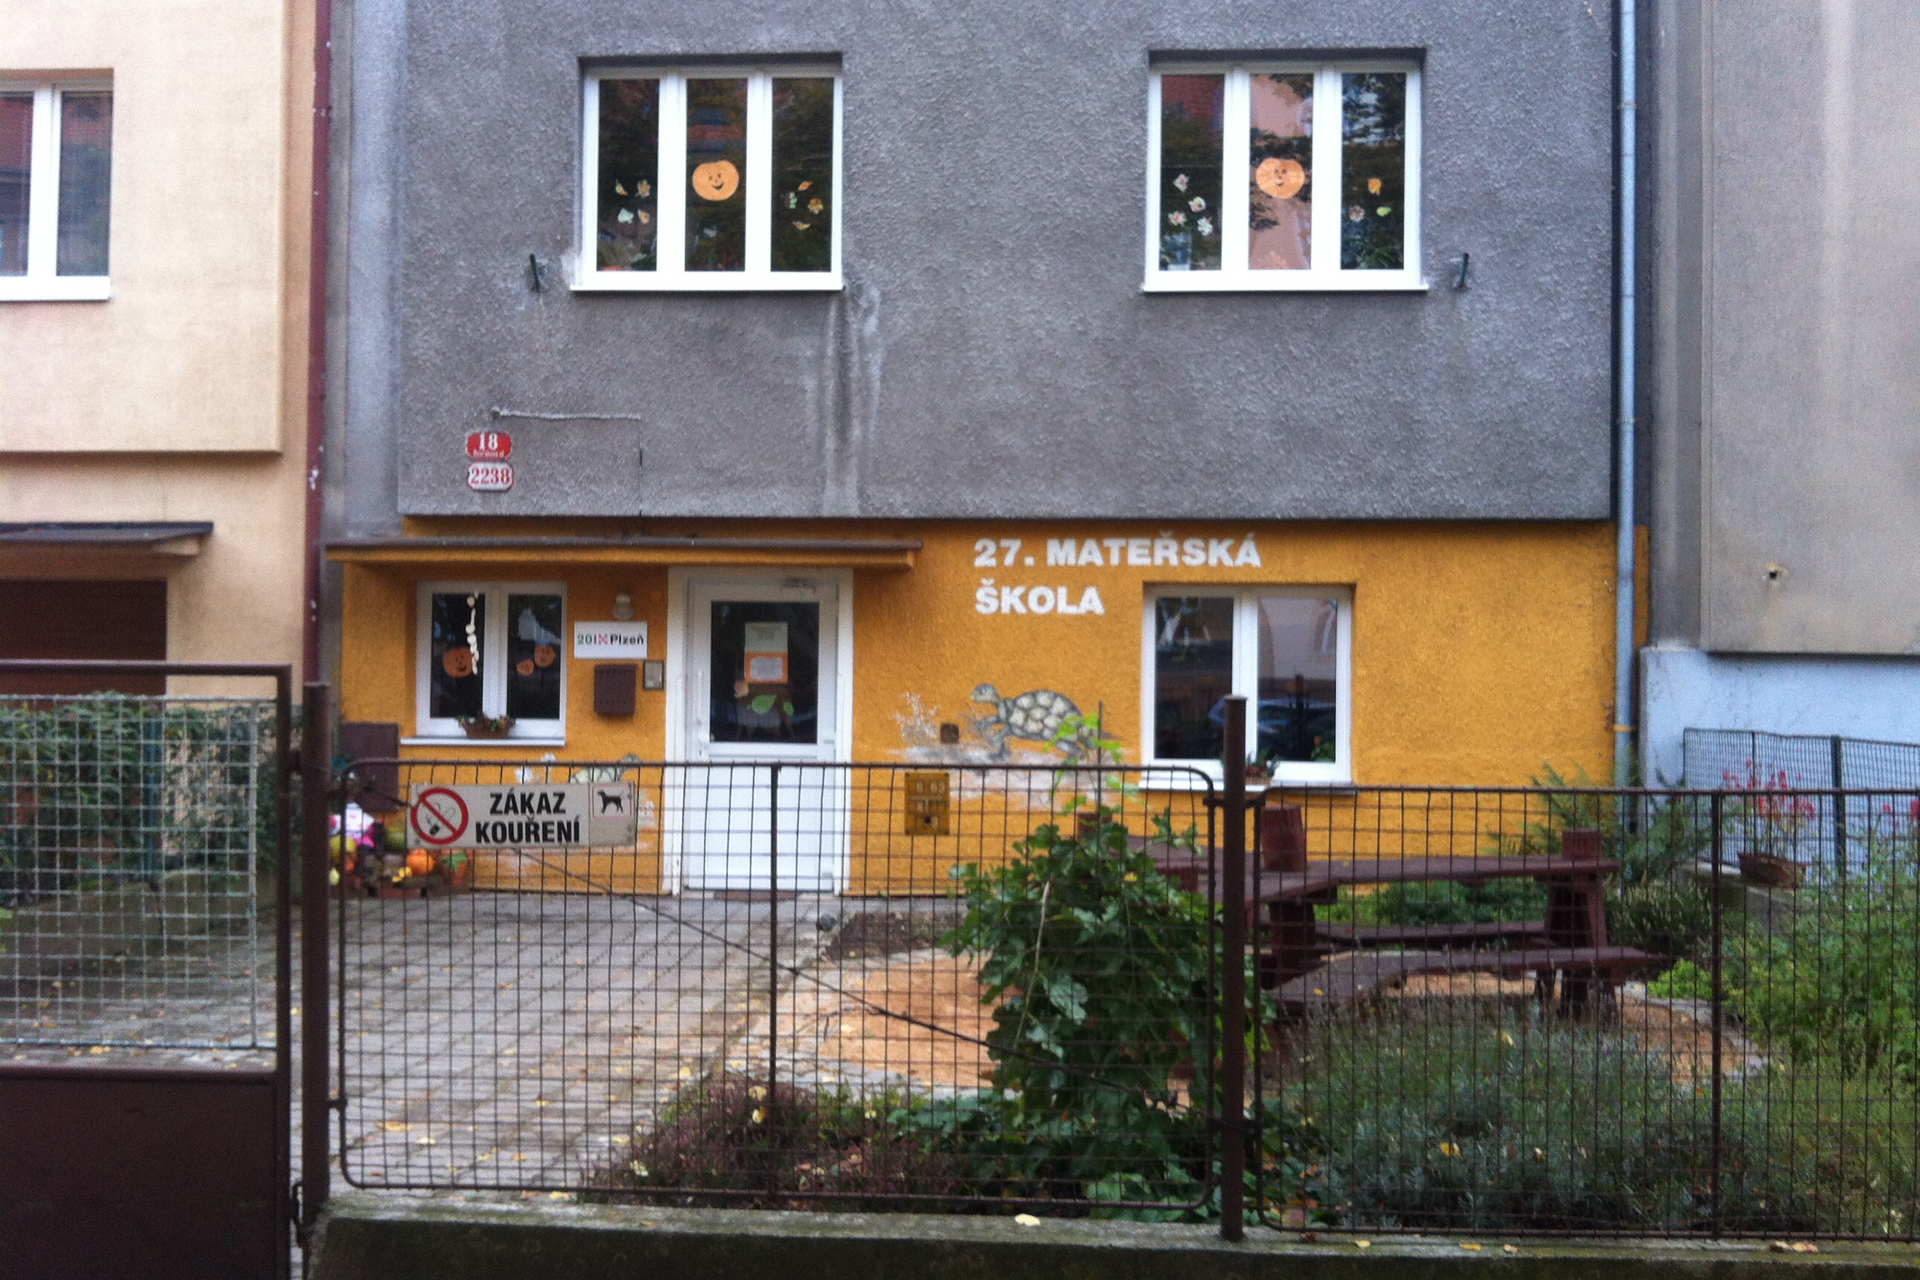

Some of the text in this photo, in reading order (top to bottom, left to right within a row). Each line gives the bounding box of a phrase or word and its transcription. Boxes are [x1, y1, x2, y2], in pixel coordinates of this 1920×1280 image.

[479, 432, 498, 450] 18
[471, 467, 510, 484] 2238
[973, 531, 1262, 568] 27. MATEŘSKÁ
[975, 577, 1105, 615] ŠKOLA
[610, 632, 644, 645] Plzeň
[489, 787, 566, 815] ZÁKAZ
[475, 814, 581, 844] KOUŘENÍ
